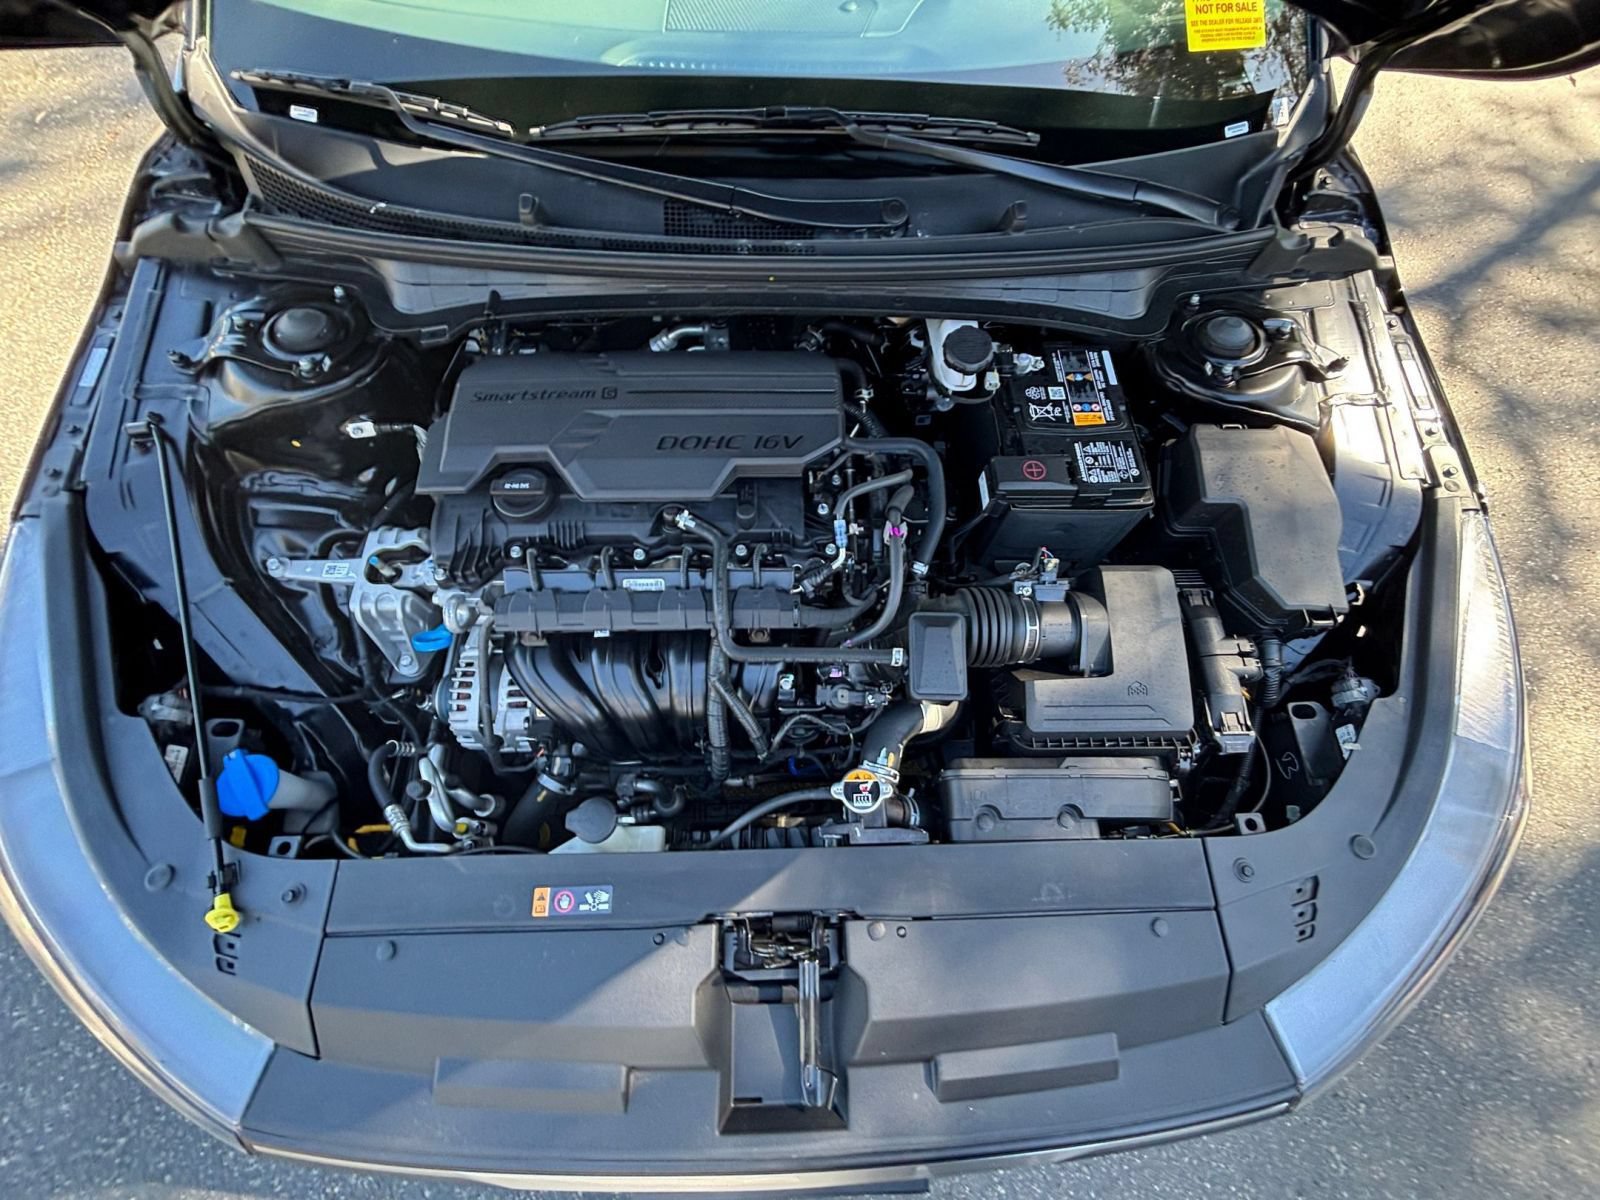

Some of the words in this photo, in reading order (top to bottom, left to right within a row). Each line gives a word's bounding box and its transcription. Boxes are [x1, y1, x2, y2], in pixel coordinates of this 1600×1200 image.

[1195, 4, 1213, 14] NOT
[1216, 3, 1233, 13] FOR
[1235, 2, 1257, 12] SALE
[472, 389, 597, 402] Smartstream
[656, 434, 746, 451] DOHC
[753, 434, 804, 450] 16V
